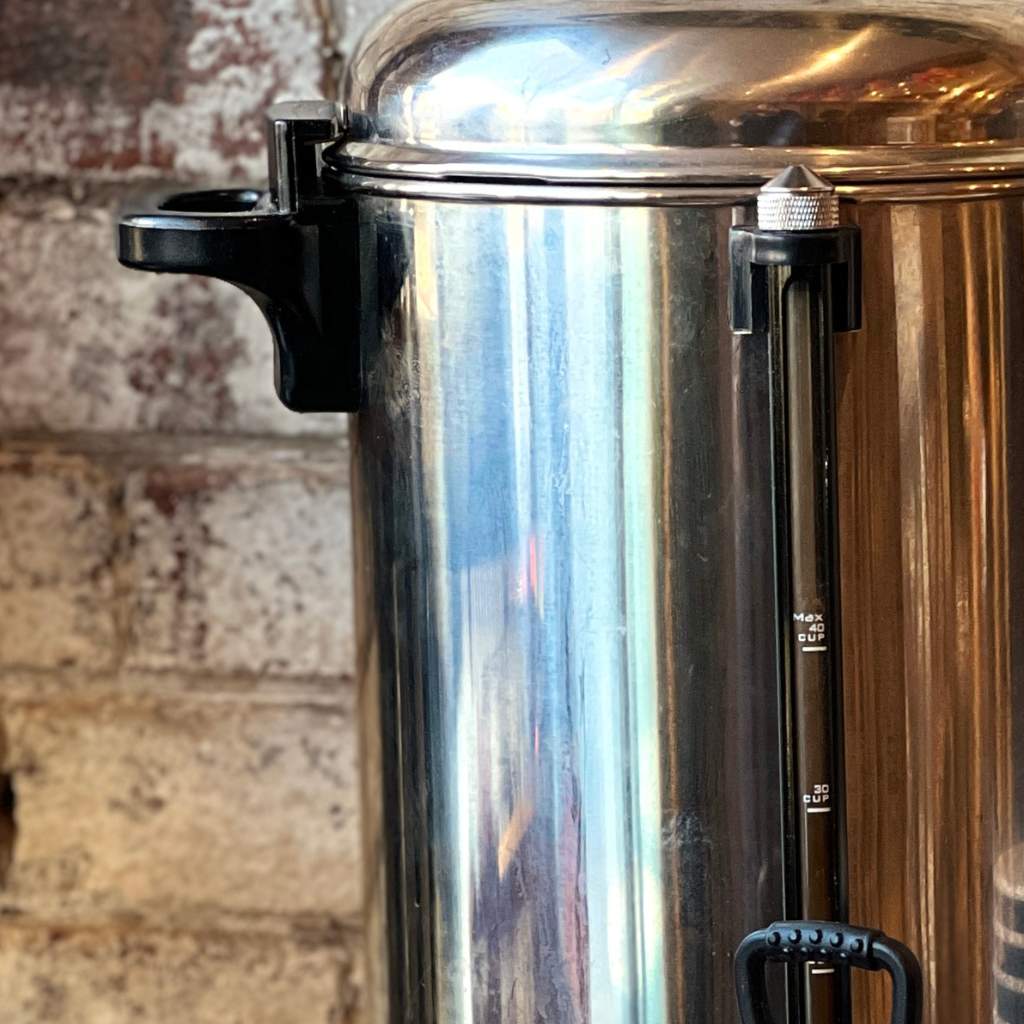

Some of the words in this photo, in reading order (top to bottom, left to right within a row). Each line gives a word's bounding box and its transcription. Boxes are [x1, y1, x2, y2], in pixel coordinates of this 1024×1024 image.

[793, 613, 823, 622] Max
[809, 623, 825, 632] 40
[798, 633, 825, 642] CUP
[814, 784, 829, 794] 30
[803, 794, 829, 803] CUP
